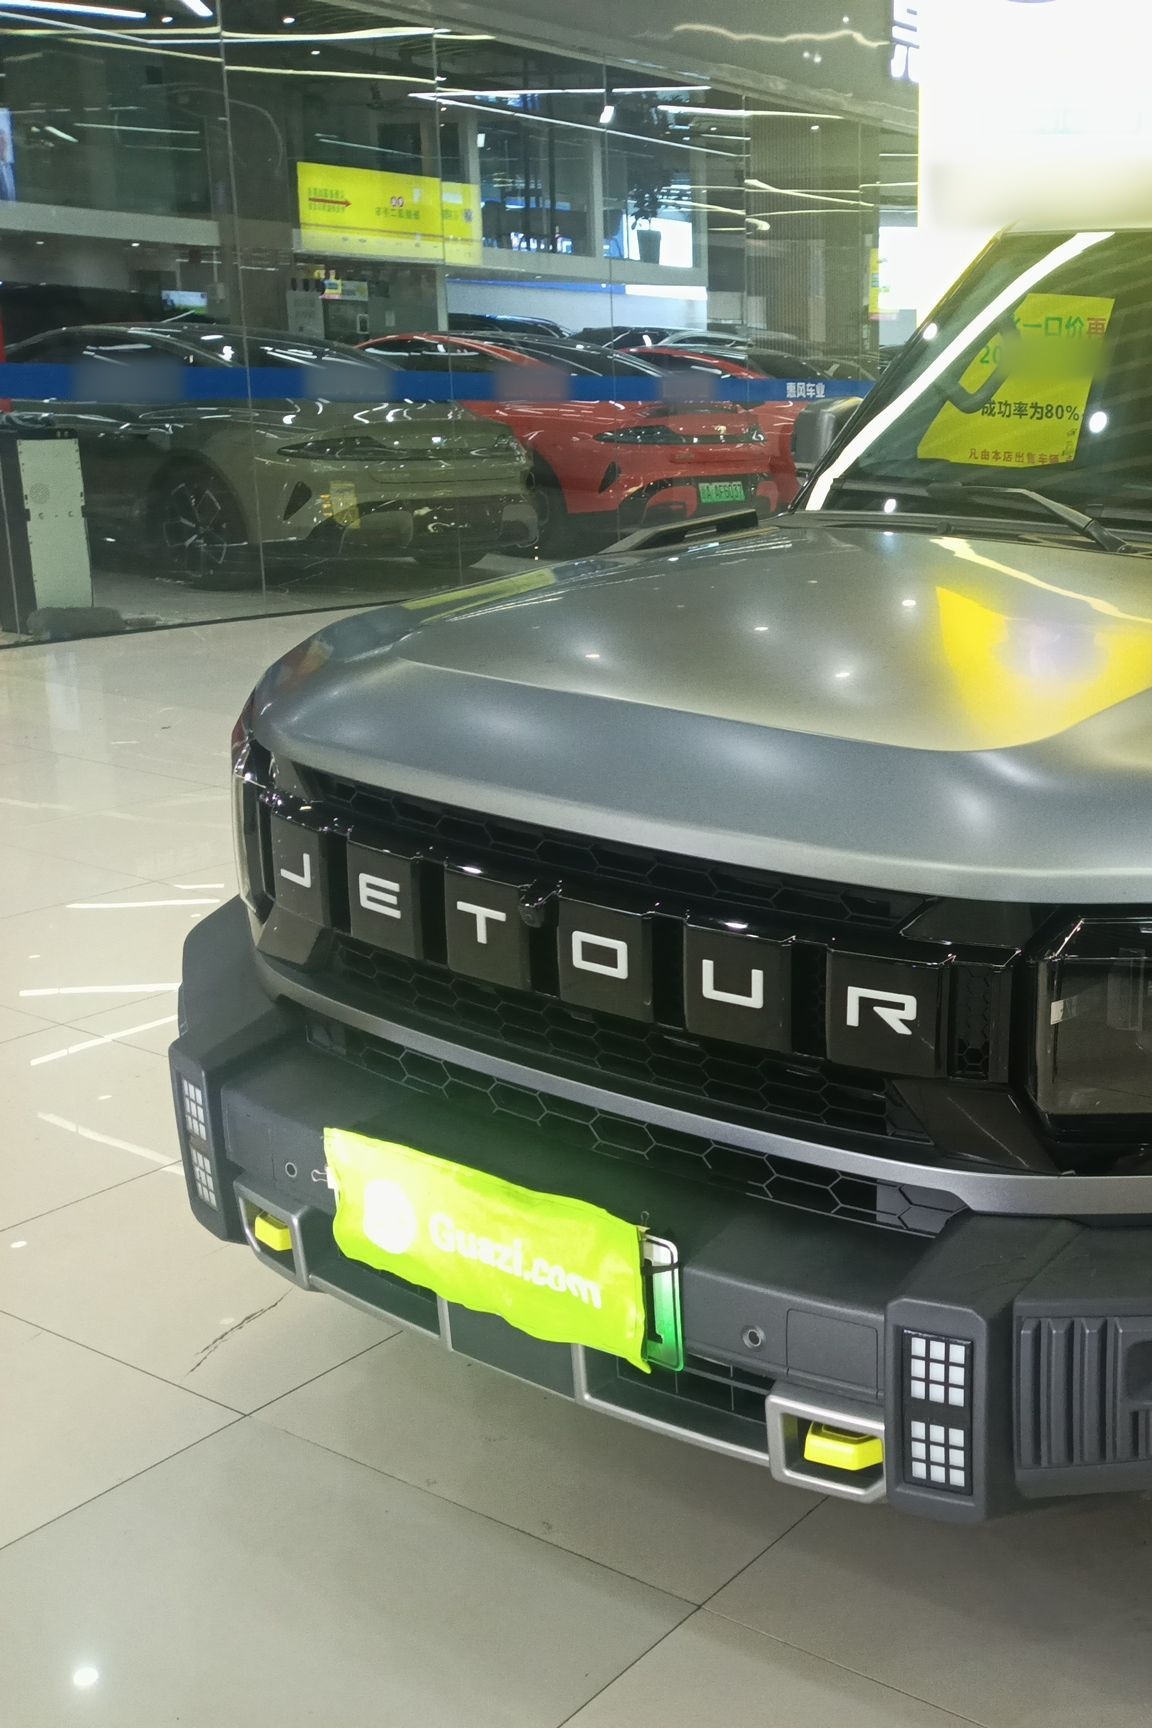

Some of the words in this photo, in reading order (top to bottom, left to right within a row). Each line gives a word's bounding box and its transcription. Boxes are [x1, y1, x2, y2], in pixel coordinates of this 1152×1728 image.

[1013, 316, 1107, 338] 一口价再
[981, 401, 1080, 421] 成功率为80%
[280, 853, 917, 1035] JETOUR
[429, 1213, 602, 1310] Guazi.com
